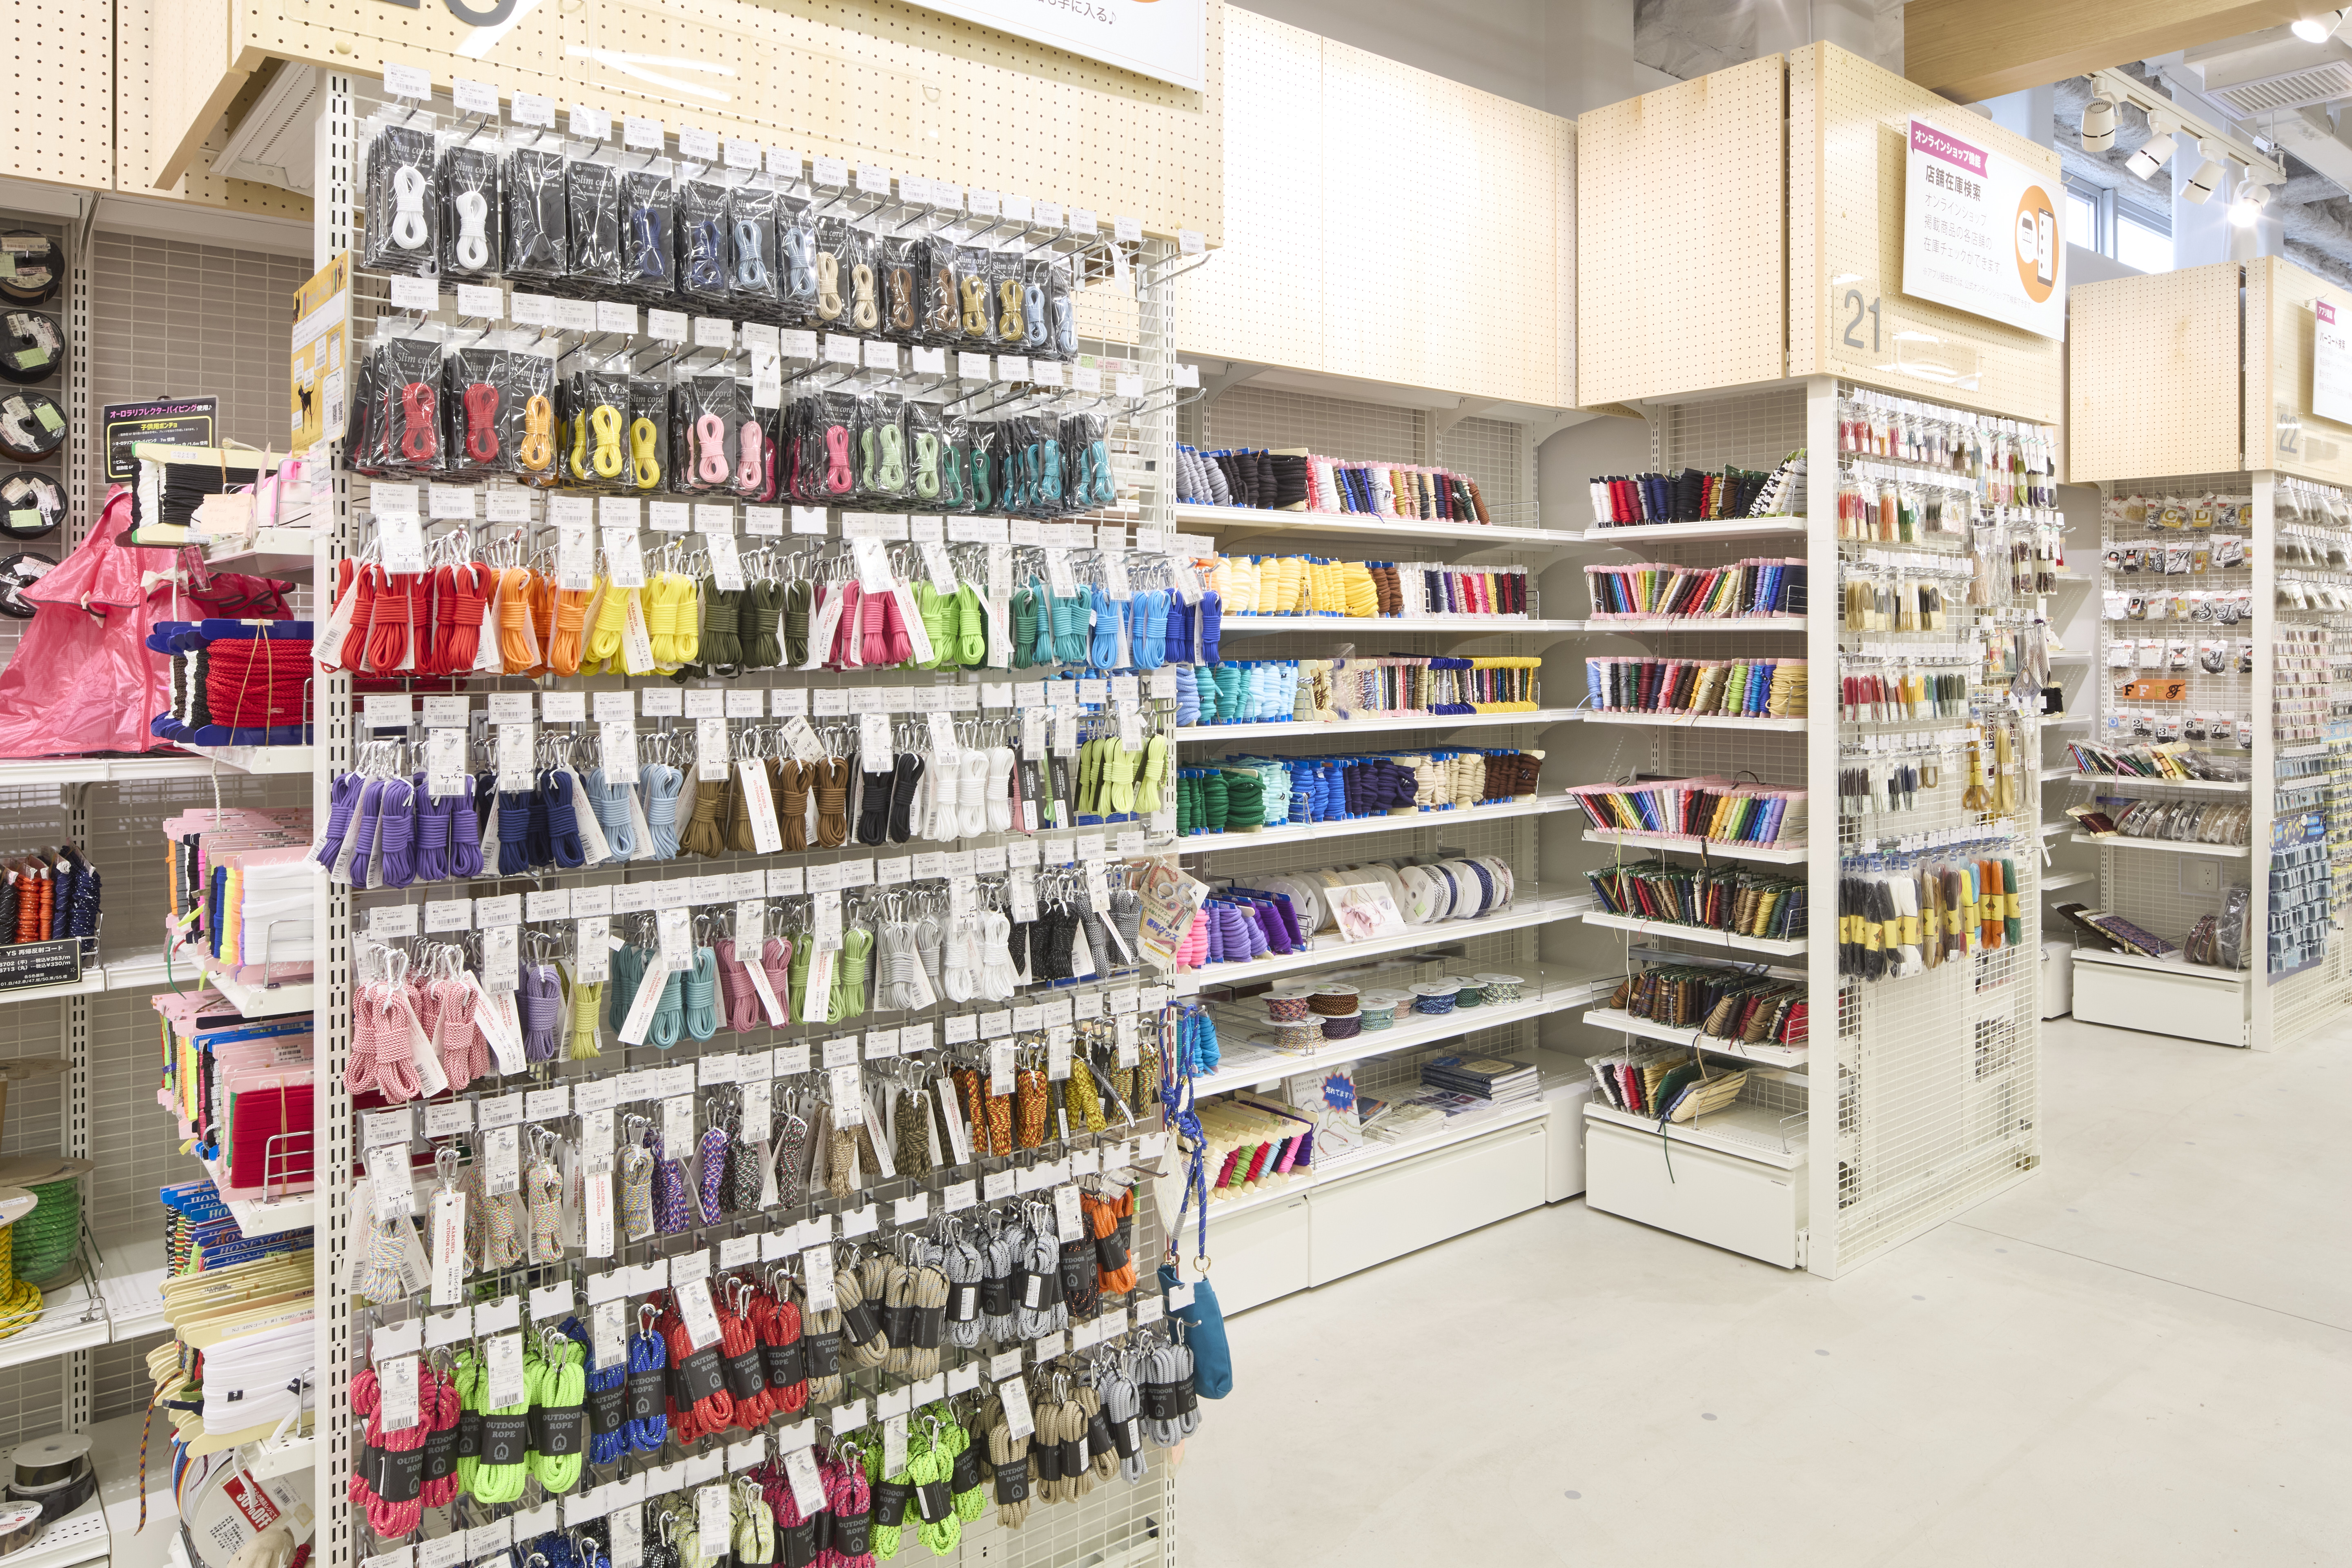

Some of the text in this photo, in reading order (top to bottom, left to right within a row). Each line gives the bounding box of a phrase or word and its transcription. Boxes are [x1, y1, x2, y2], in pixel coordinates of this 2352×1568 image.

[390, 140, 431, 156] Slim cord
[1915, 129, 1981, 168] オンラインショップ機能
[455, 161, 493, 175] Slim cord
[523, 163, 560, 176] Slim cord
[576, 174, 612, 187] Slim cord
[1925, 164, 1981, 202] 店舗在庫検索
[633, 185, 669, 198] Slim cord
[691, 194, 723, 207] Slim cord
[736, 199, 753, 208] Slim
[1925, 192, 1987, 226] オンラインショップ
[1924, 213, 1992, 250] 掲載商品の各店舗の
[886, 247, 916, 258] Slim cord
[1924, 236, 2002, 276] 在庫チェックができます。
[958, 255, 987, 265] Slim cord
[993, 261, 1021, 271] Slim cord
[1844, 289, 1880, 352] 21
[396, 352, 437, 365] Slim cord
[465, 362, 505, 372] Slim cord
[515, 366, 549, 380] Slim cord
[608, 385, 625, 394] cord
[697, 388, 732, 398] Slim cord
[629, 393, 664, 403] Slim cord
[140, 422, 178, 431] 子供用ポンチョ
[2280, 414, 2297, 454] 22
[2165, 510, 2177, 521] C
[630, 602, 638, 627] MÄRCHEN
[2125, 684, 2165, 697] F F F
[2213, 724, 2220, 732] 7
[759, 785, 767, 809] MÄRCHEN
[1148, 901, 1175, 920] アウトドアコード
[1146, 918, 1180, 942] 便利グッズ
[18, 945, 63, 956] 再帰反射コード
[648, 970, 660, 993] OUTDOOR
[649, 976, 662, 1001] MÄRCHEN
[497, 994, 506, 1020] OUTDOOR
[1325, 1086, 1354, 1101] 売れてます!!
[1064, 1262, 1080, 1271] ROPE
[768, 1349, 795, 1359] UTDOOR
[701, 1360, 719, 1372] ROPE
[744, 1361, 760, 1374] ROPE
[633, 1385, 653, 1393] ROPE
[592, 1388, 625, 1404] OUTDOOR
[600, 1399, 622, 1411] ROPE
[543, 1412, 580, 1421] OUTDOOR
[486, 1421, 524, 1429] OUTDOOR
[428, 1443, 451, 1454] ROPE
[397, 1452, 423, 1465] OUTDO
[1006, 1473, 1024, 1482] ROPE
[253, 1486, 278, 1519] ちらの商品レジにて
[880, 1496, 897, 1504] ROPE
[846, 1526, 866, 1535] ROPE
